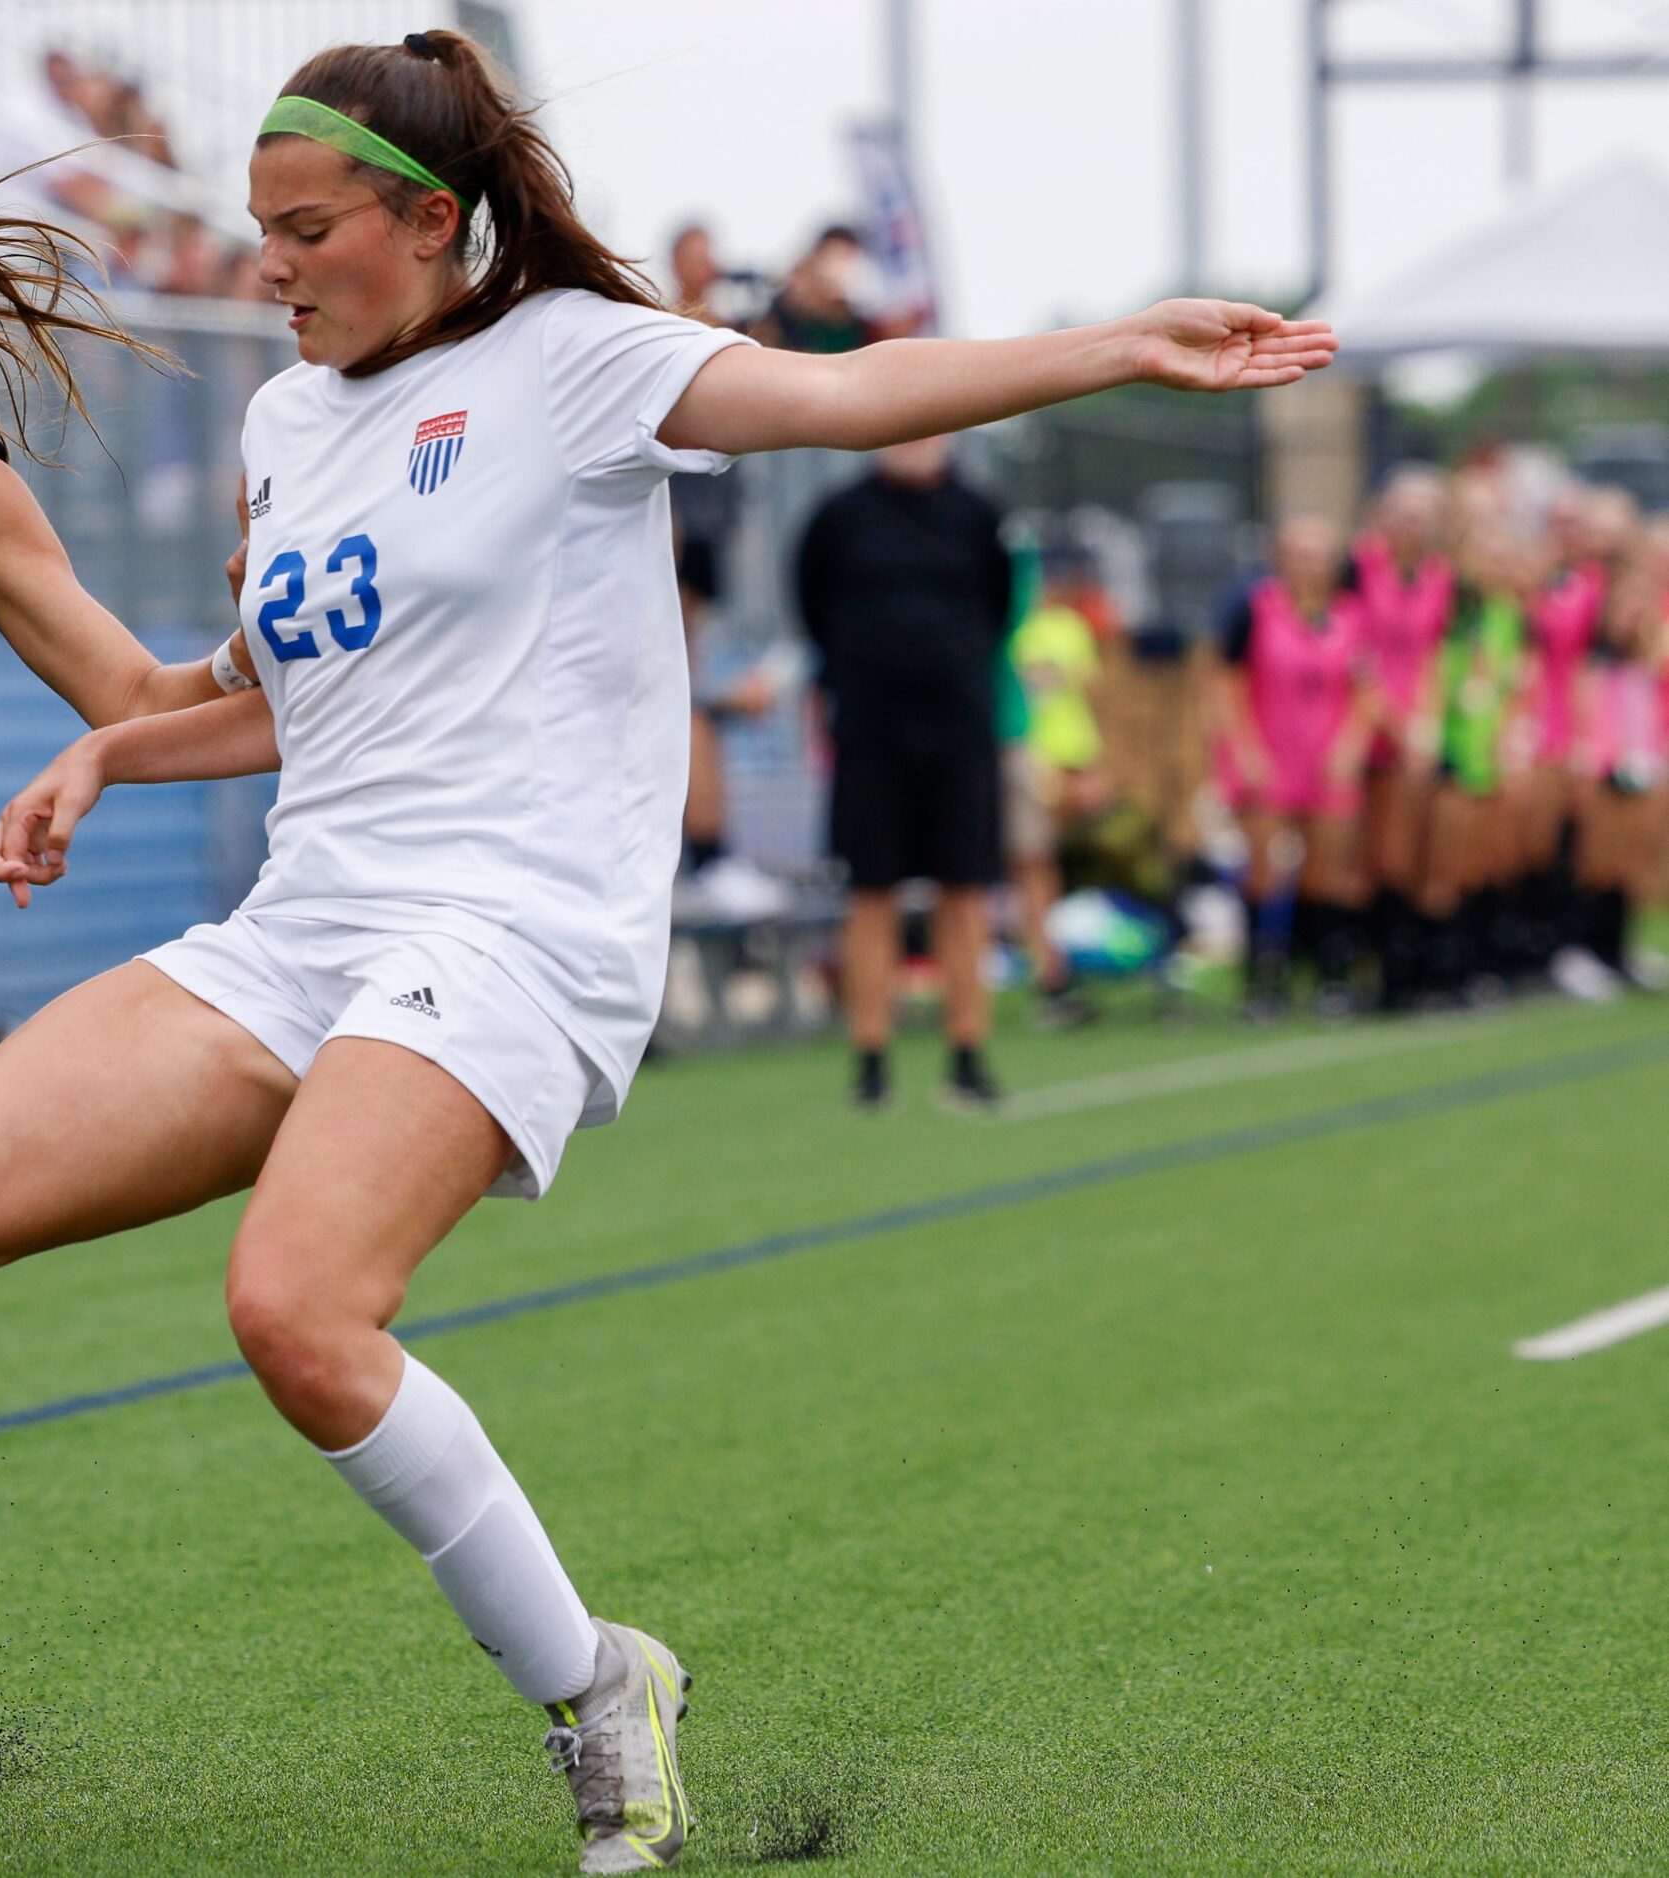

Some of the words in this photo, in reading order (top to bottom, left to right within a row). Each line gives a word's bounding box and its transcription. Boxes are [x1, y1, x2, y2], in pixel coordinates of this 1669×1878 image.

[415, 423, 463, 443] SOCCER
[258, 534, 382, 664] 23
[390, 997, 441, 1020] adidas
